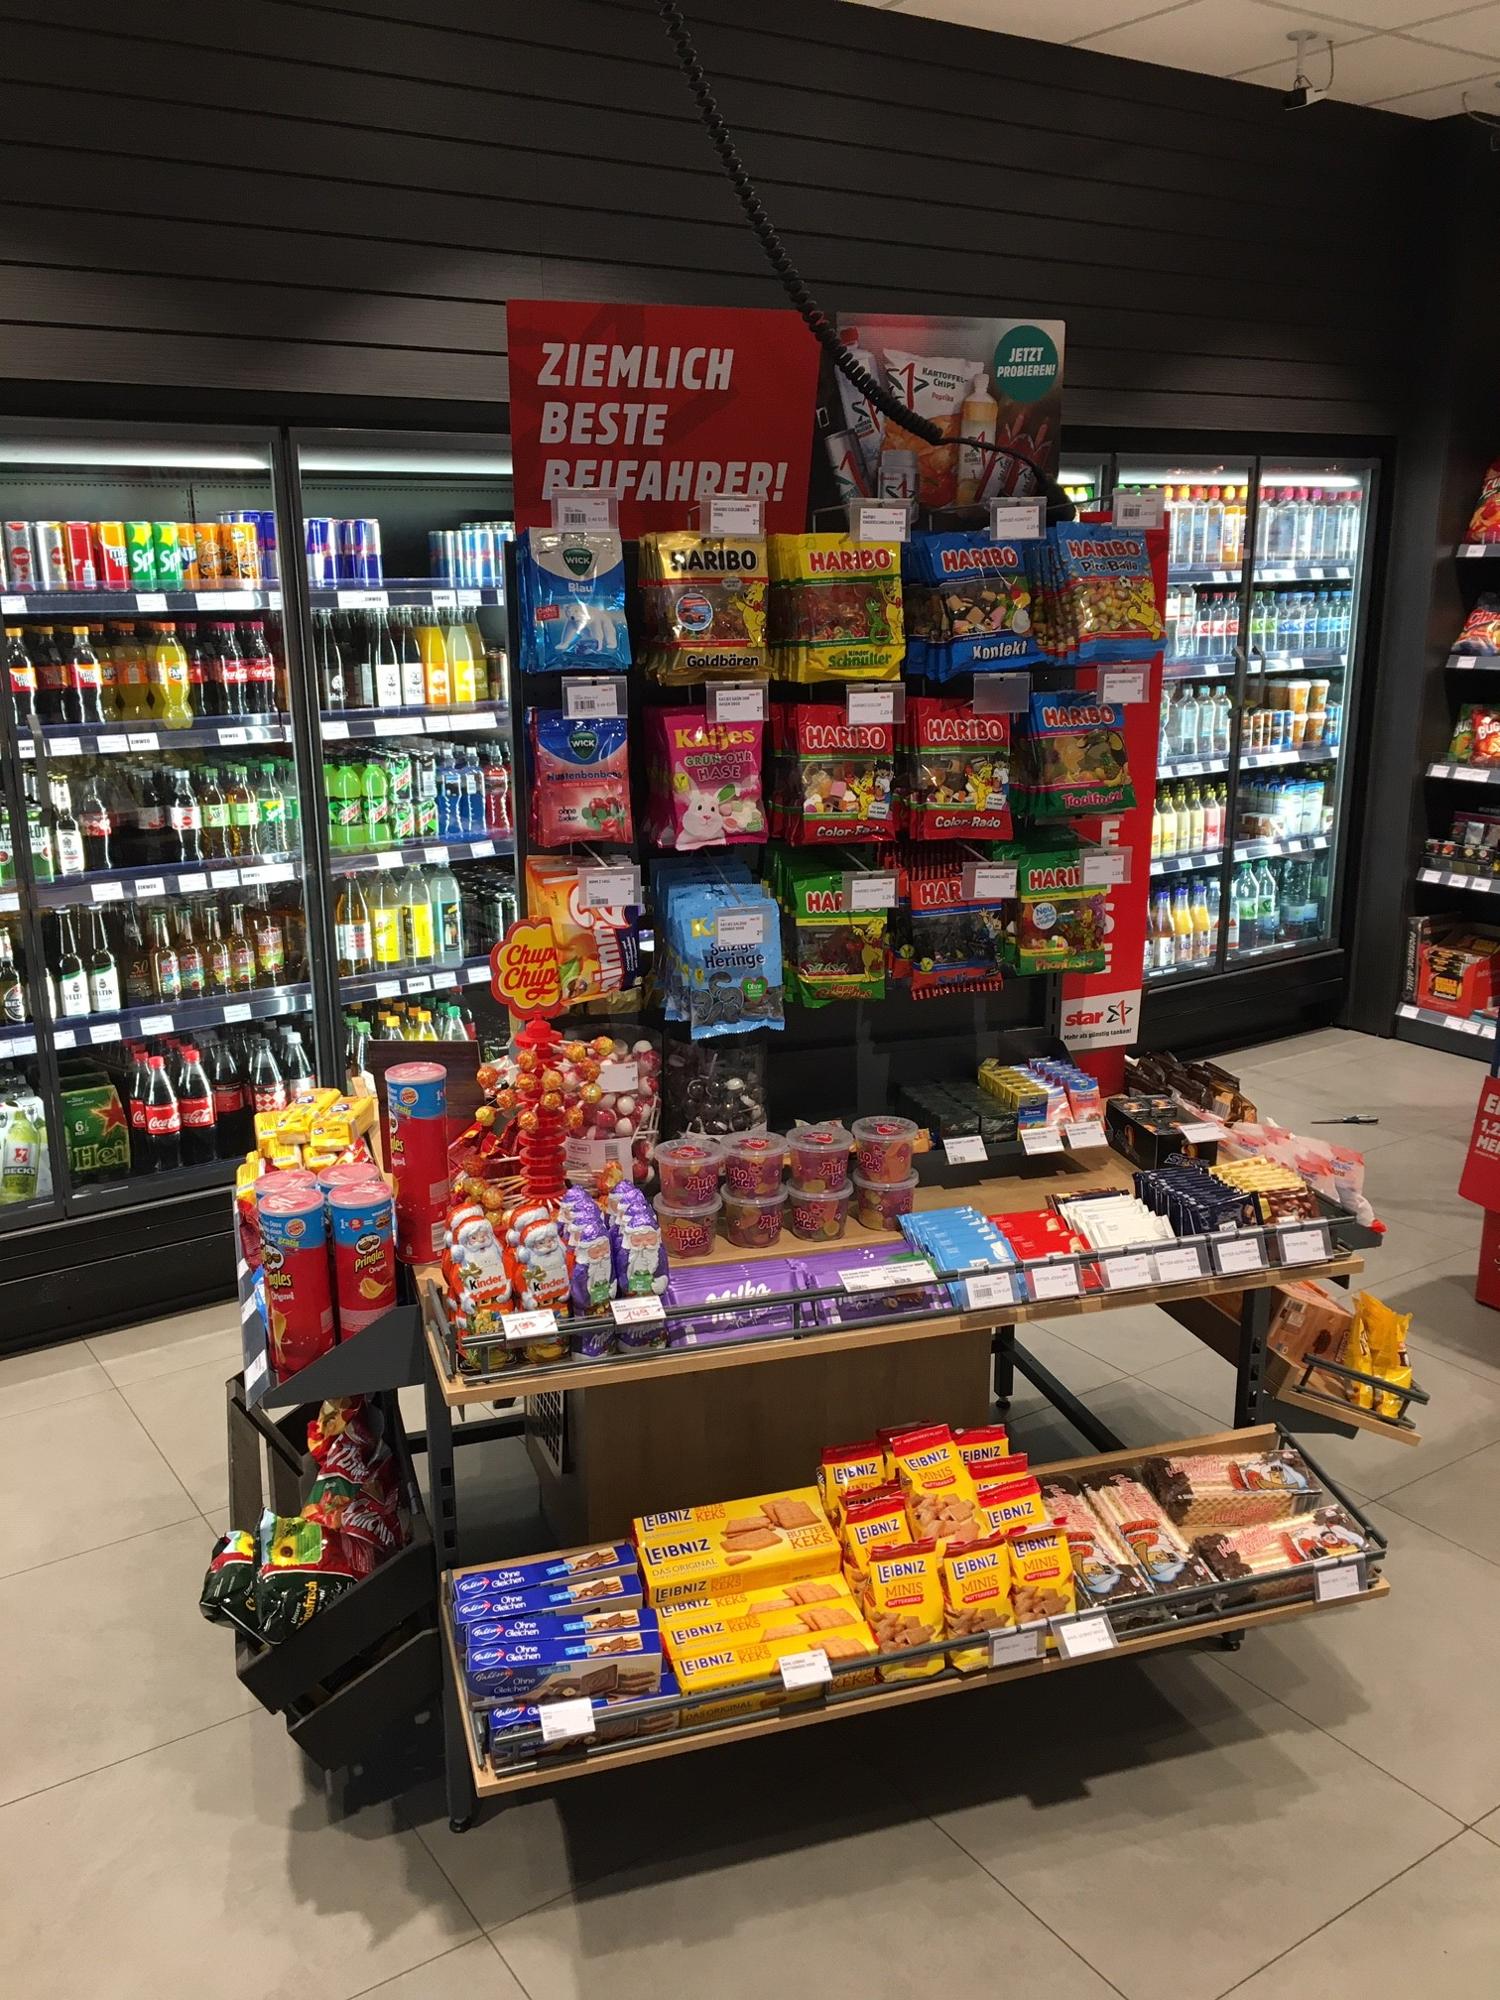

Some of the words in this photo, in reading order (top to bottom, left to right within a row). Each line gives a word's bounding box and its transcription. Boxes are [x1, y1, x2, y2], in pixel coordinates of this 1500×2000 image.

[1008, 347, 1044, 363] JETZT
[537, 342, 734, 391] ZIEMLICH
[997, 363, 1056, 378] PROBIEREN!
[539, 401, 668, 445] BESTE
[541, 459, 788, 501] BEIFAHRER!
[1066, 539, 1141, 559] HARIBO
[565, 555, 591, 565] WICK
[670, 550, 757, 571] HARIBO
[809, 548, 892, 572] HARIBO
[941, 546, 1018, 573] HARIBO
[567, 582, 593, 593] Blau
[972, 640, 1027, 660] Konfekt
[686, 654, 759, 668] Goldbären
[828, 652, 892, 668] Schnuller
[1044, 705, 1115, 728] HARIBO
[674, 726, 756, 751] Katjes
[806, 725, 886, 750] HARIBO
[927, 718, 1004, 742] HARIBO
[570, 739, 595, 749] WICK
[684, 750, 753, 767] GRÜN-OHR
[697, 765, 741, 782] HASE
[558, 806, 577, 815] ohne
[935, 816, 1001, 829] Color-Rado
[1028, 867, 1080, 891] HARI
[920, 880, 962, 905] HAR
[1035, 906, 1053, 917] Neu
[704, 953, 766, 970] Heringe
[1064, 1009, 1104, 1027] star
[1064, 1032, 1079, 1041] Mehr
[1088, 1030, 1109, 1039] günstig
[1110, 1028, 1132, 1037] tanken!
[75, 1120, 84, 1132] 6
[148, 1112, 181, 1129] Coca-Cola
[355, 1249, 385, 1273] Pringles
[469, 1274, 503, 1291] Kinder
[704, 1281, 773, 1324] Milka
[905, 1448, 950, 1470] LEIBNIZ
[833, 1462, 878, 1484] LEIBNIZ
[918, 1466, 953, 1480] MINIS
[642, 1508, 692, 1532] LEIBNIZ
[696, 1509, 726, 1522] KEKS
[988, 1502, 1034, 1528] LEIBNIZ
[786, 1524, 827, 1538] BUTTER
[855, 1520, 900, 1544] LEIBNIZ
[790, 1532, 833, 1550] KEKS
[1014, 1536, 1059, 1558] LEIBNIZ
[646, 1539, 711, 1566] LEIBNIZ
[652, 1567, 671, 1577] DAS
[672, 1559, 717, 1573] ORIGINAL
[877, 1560, 926, 1584] LEIBNIZ
[952, 1553, 999, 1580] LEIBNIZ
[1023, 1555, 1059, 1572] MINIS
[492, 1576, 525, 1588] Gleichen
[499, 1570, 520, 1579] Ohne
[656, 1580, 707, 1602] LEIBNIZ
[885, 1581, 923, 1598] MINIS
[961, 1575, 999, 1594] MINIS
[492, 1600, 527, 1612] Gleichen
[500, 1595, 523, 1604] Ohne
[716, 1594, 748, 1607] KEKS
[291, 1602, 301, 1624] Unsere
[505, 1626, 540, 1637] Gleichen
[514, 1621, 537, 1630] Ohne
[671, 1622, 725, 1645] LEIBNIZ
[728, 1620, 761, 1633] KEKS
[506, 1650, 541, 1662] Gleichen
[515, 1645, 538, 1654] Ohne
[680, 1652, 734, 1676] LEIBNIZ
[738, 1649, 772, 1664] KEKS
[494, 1685, 530, 1694] Gleichen
[513, 1677, 536, 1685] Ohne
